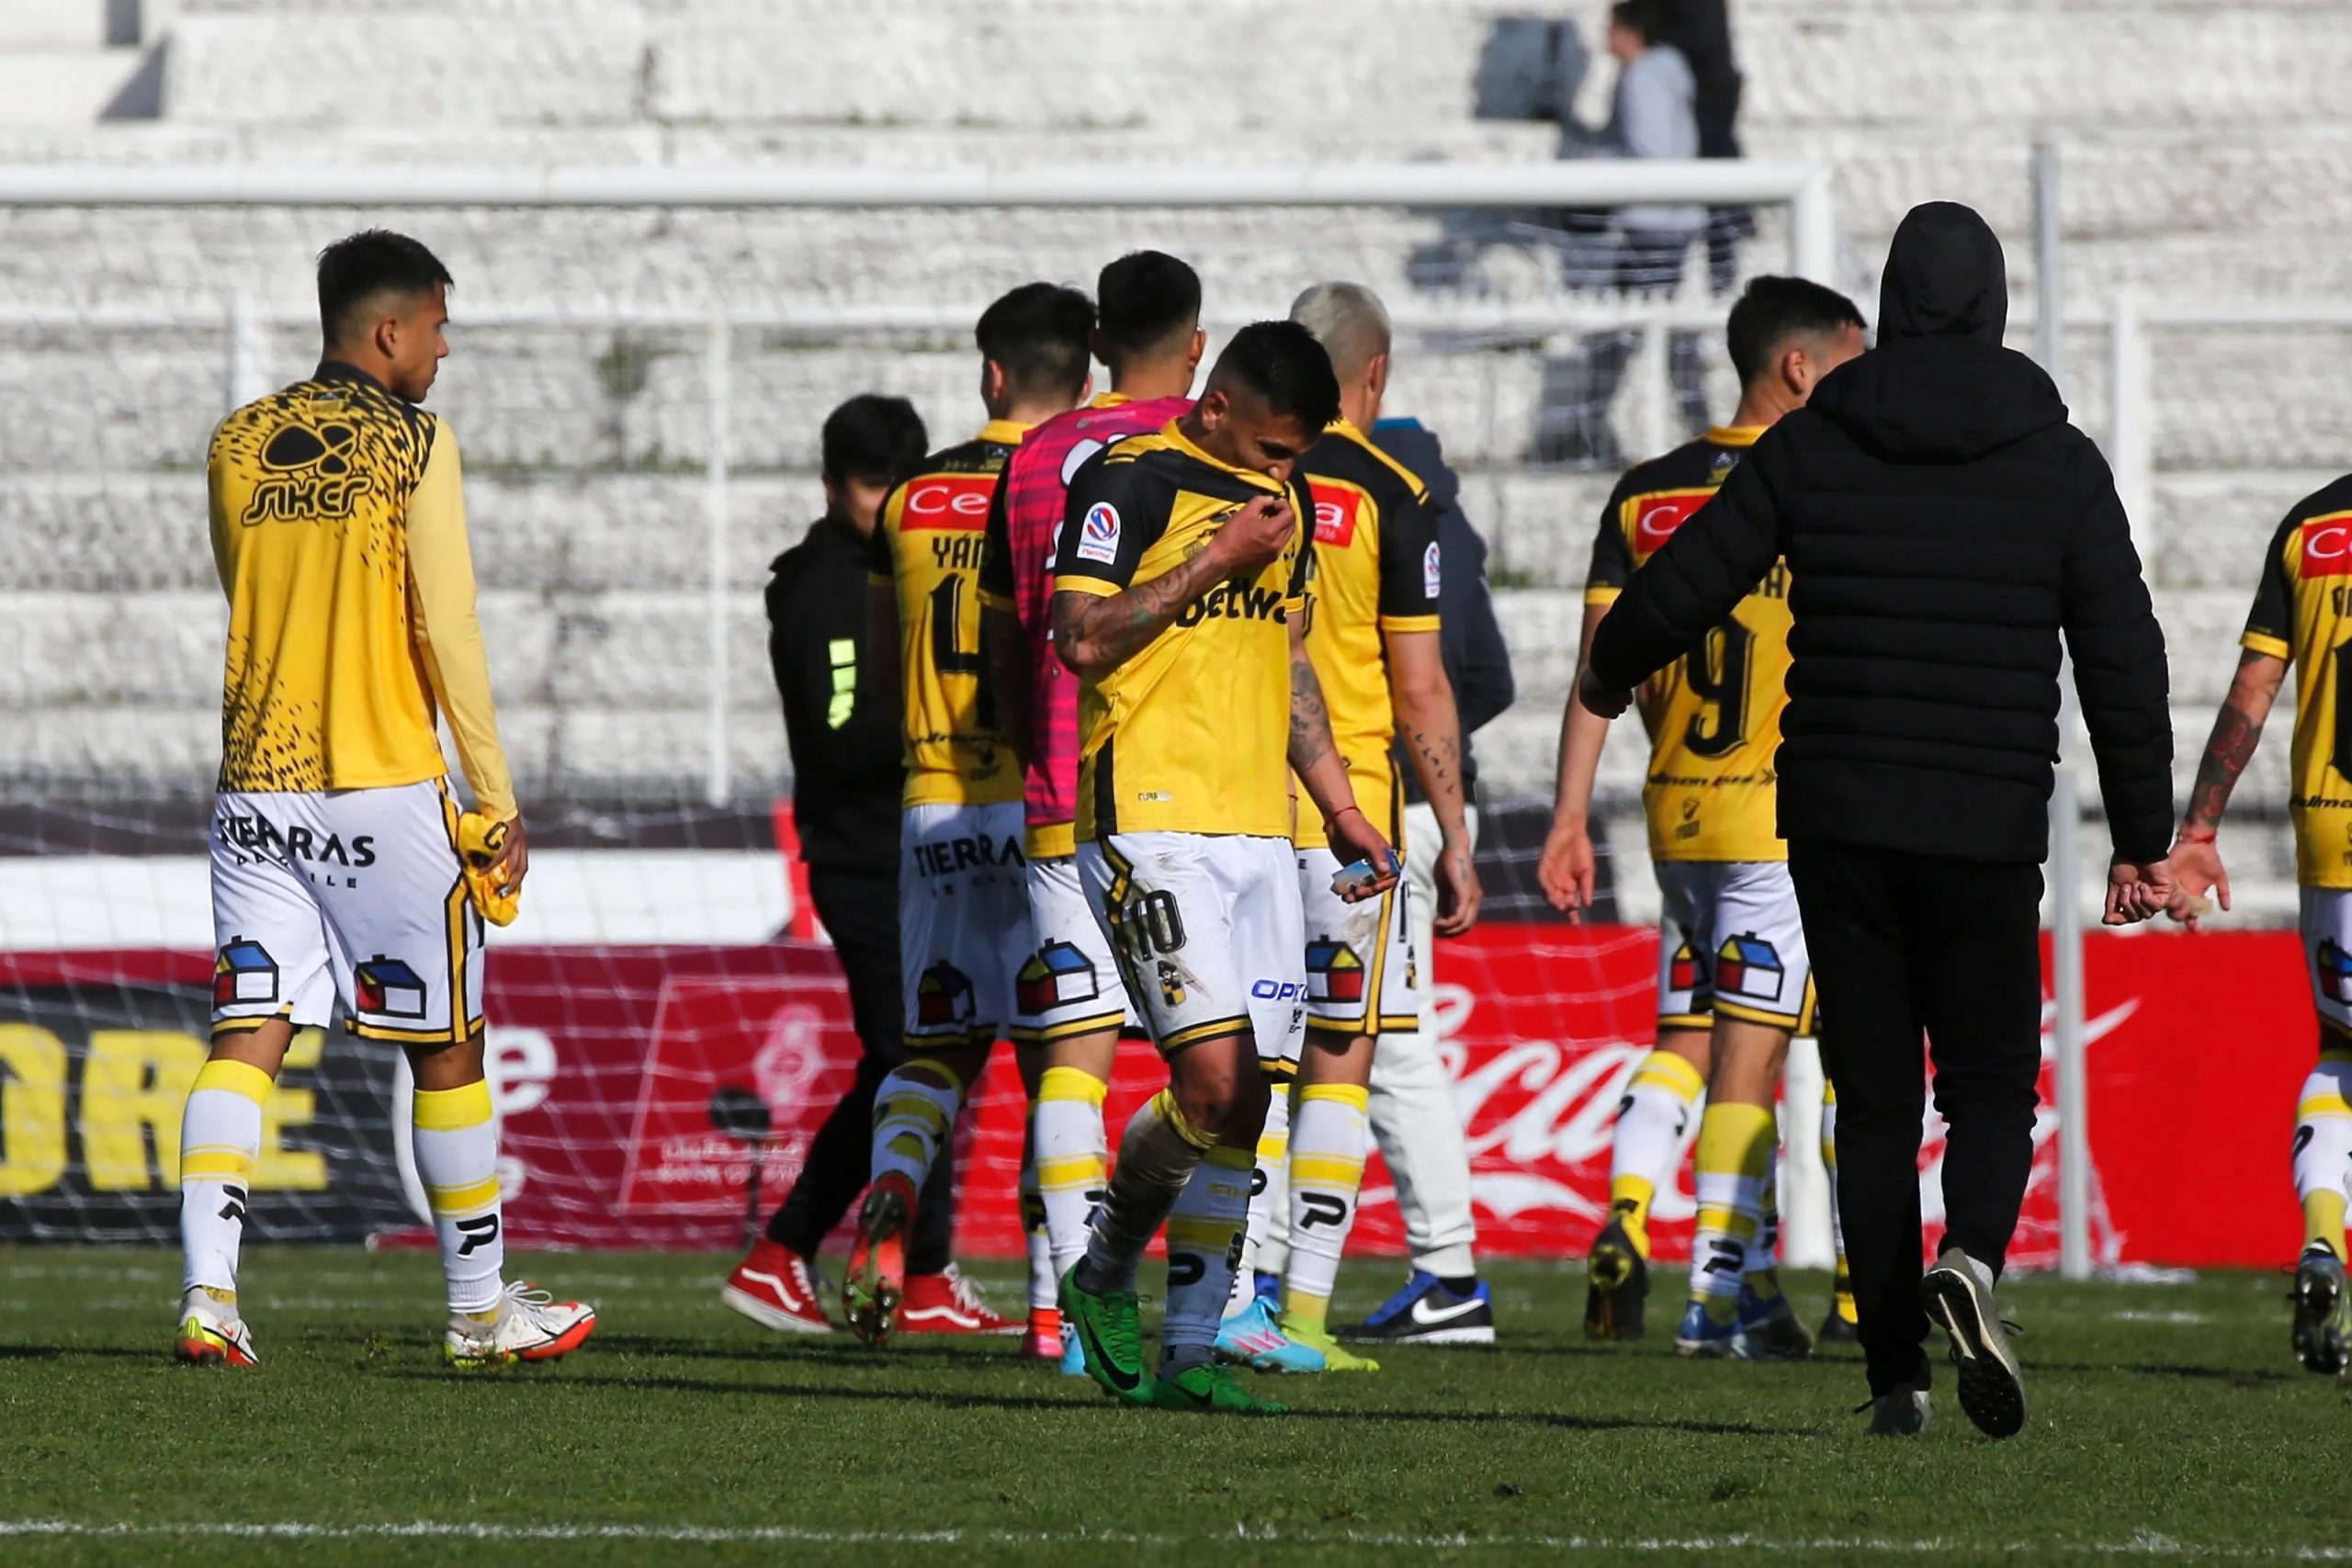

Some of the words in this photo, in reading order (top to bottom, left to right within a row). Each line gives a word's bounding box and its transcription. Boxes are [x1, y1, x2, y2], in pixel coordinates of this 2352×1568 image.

[1685, 613, 1755, 759] 9
[913, 834, 1026, 878] TIERRA
[1130, 889, 1186, 962] 10
